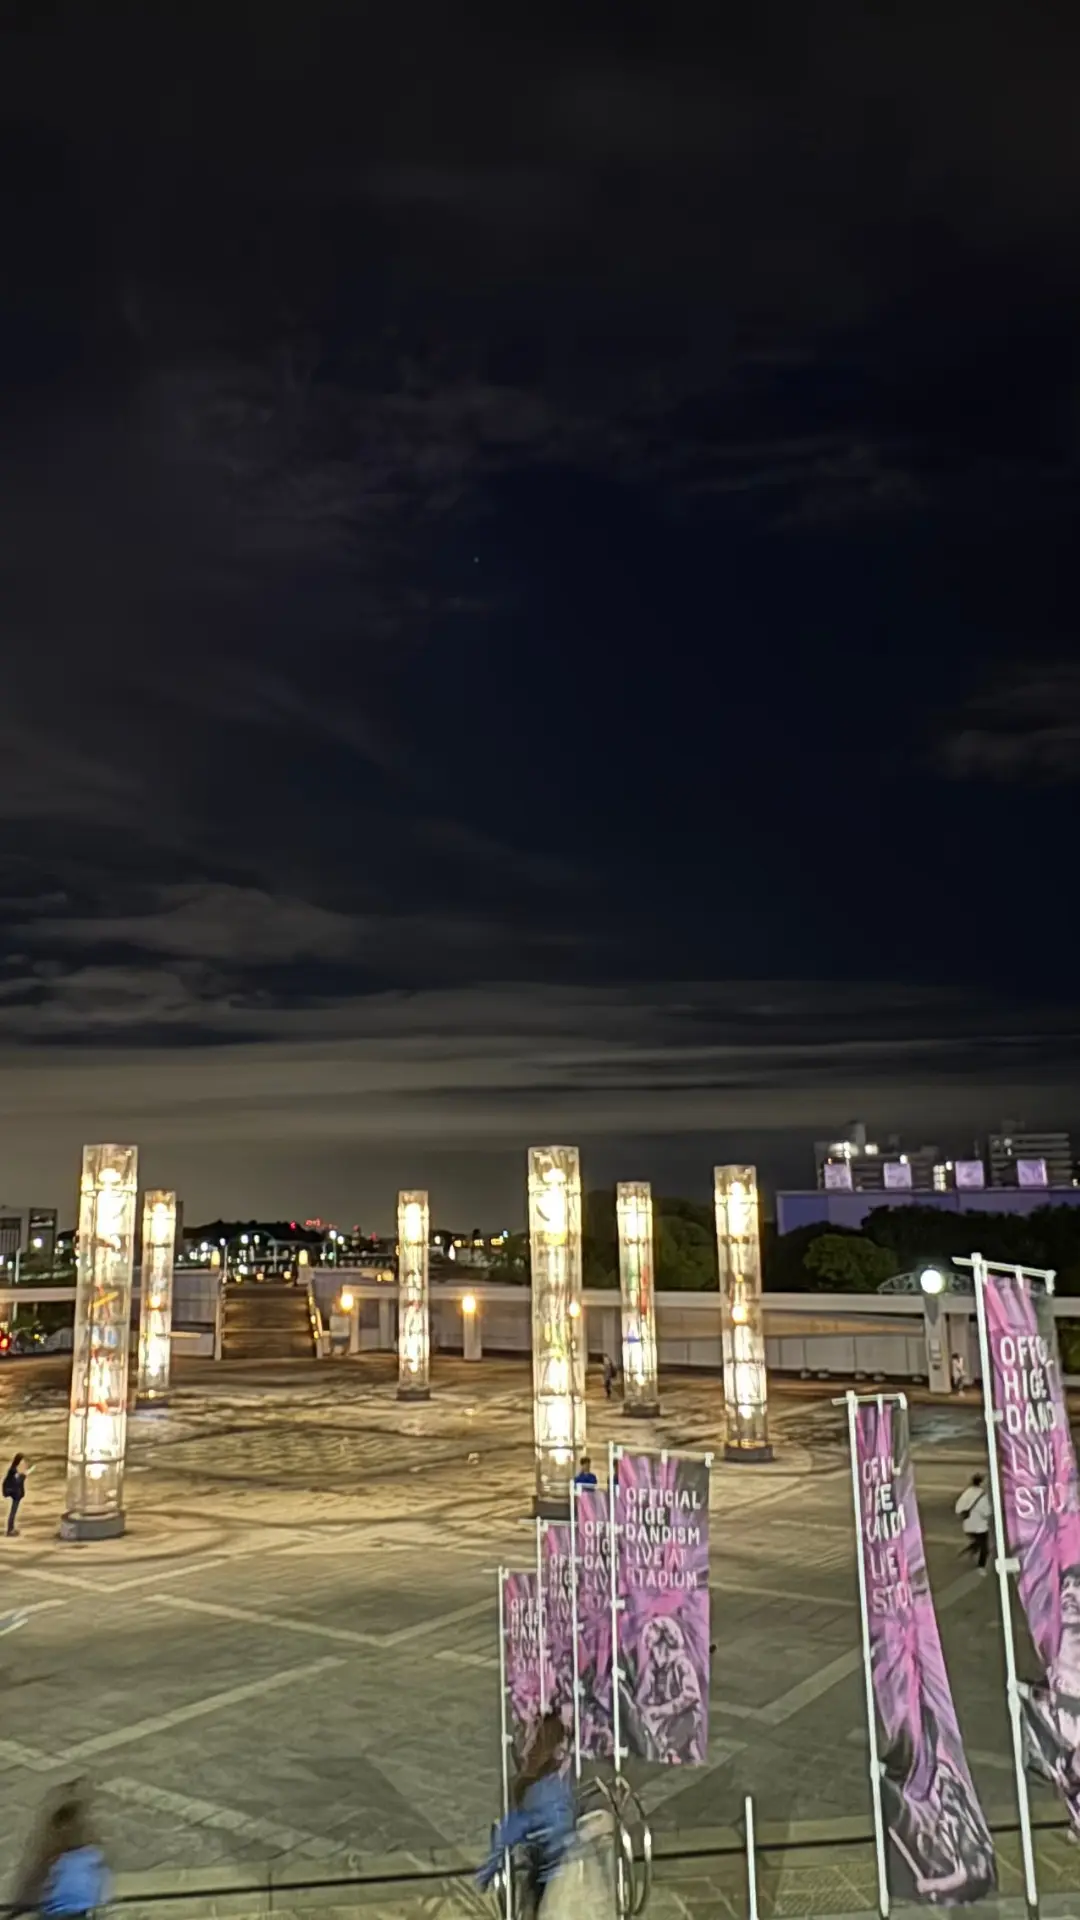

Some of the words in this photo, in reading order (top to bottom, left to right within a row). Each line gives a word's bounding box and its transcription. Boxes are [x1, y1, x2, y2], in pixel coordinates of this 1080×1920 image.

[626, 1487, 701, 1510] OFFICIAL
[626, 1506, 666, 1525] HIGE
[626, 1523, 700, 1545] DANDISM
[626, 1543, 662, 1566] LIVE
[668, 1548, 686, 1569] AT
